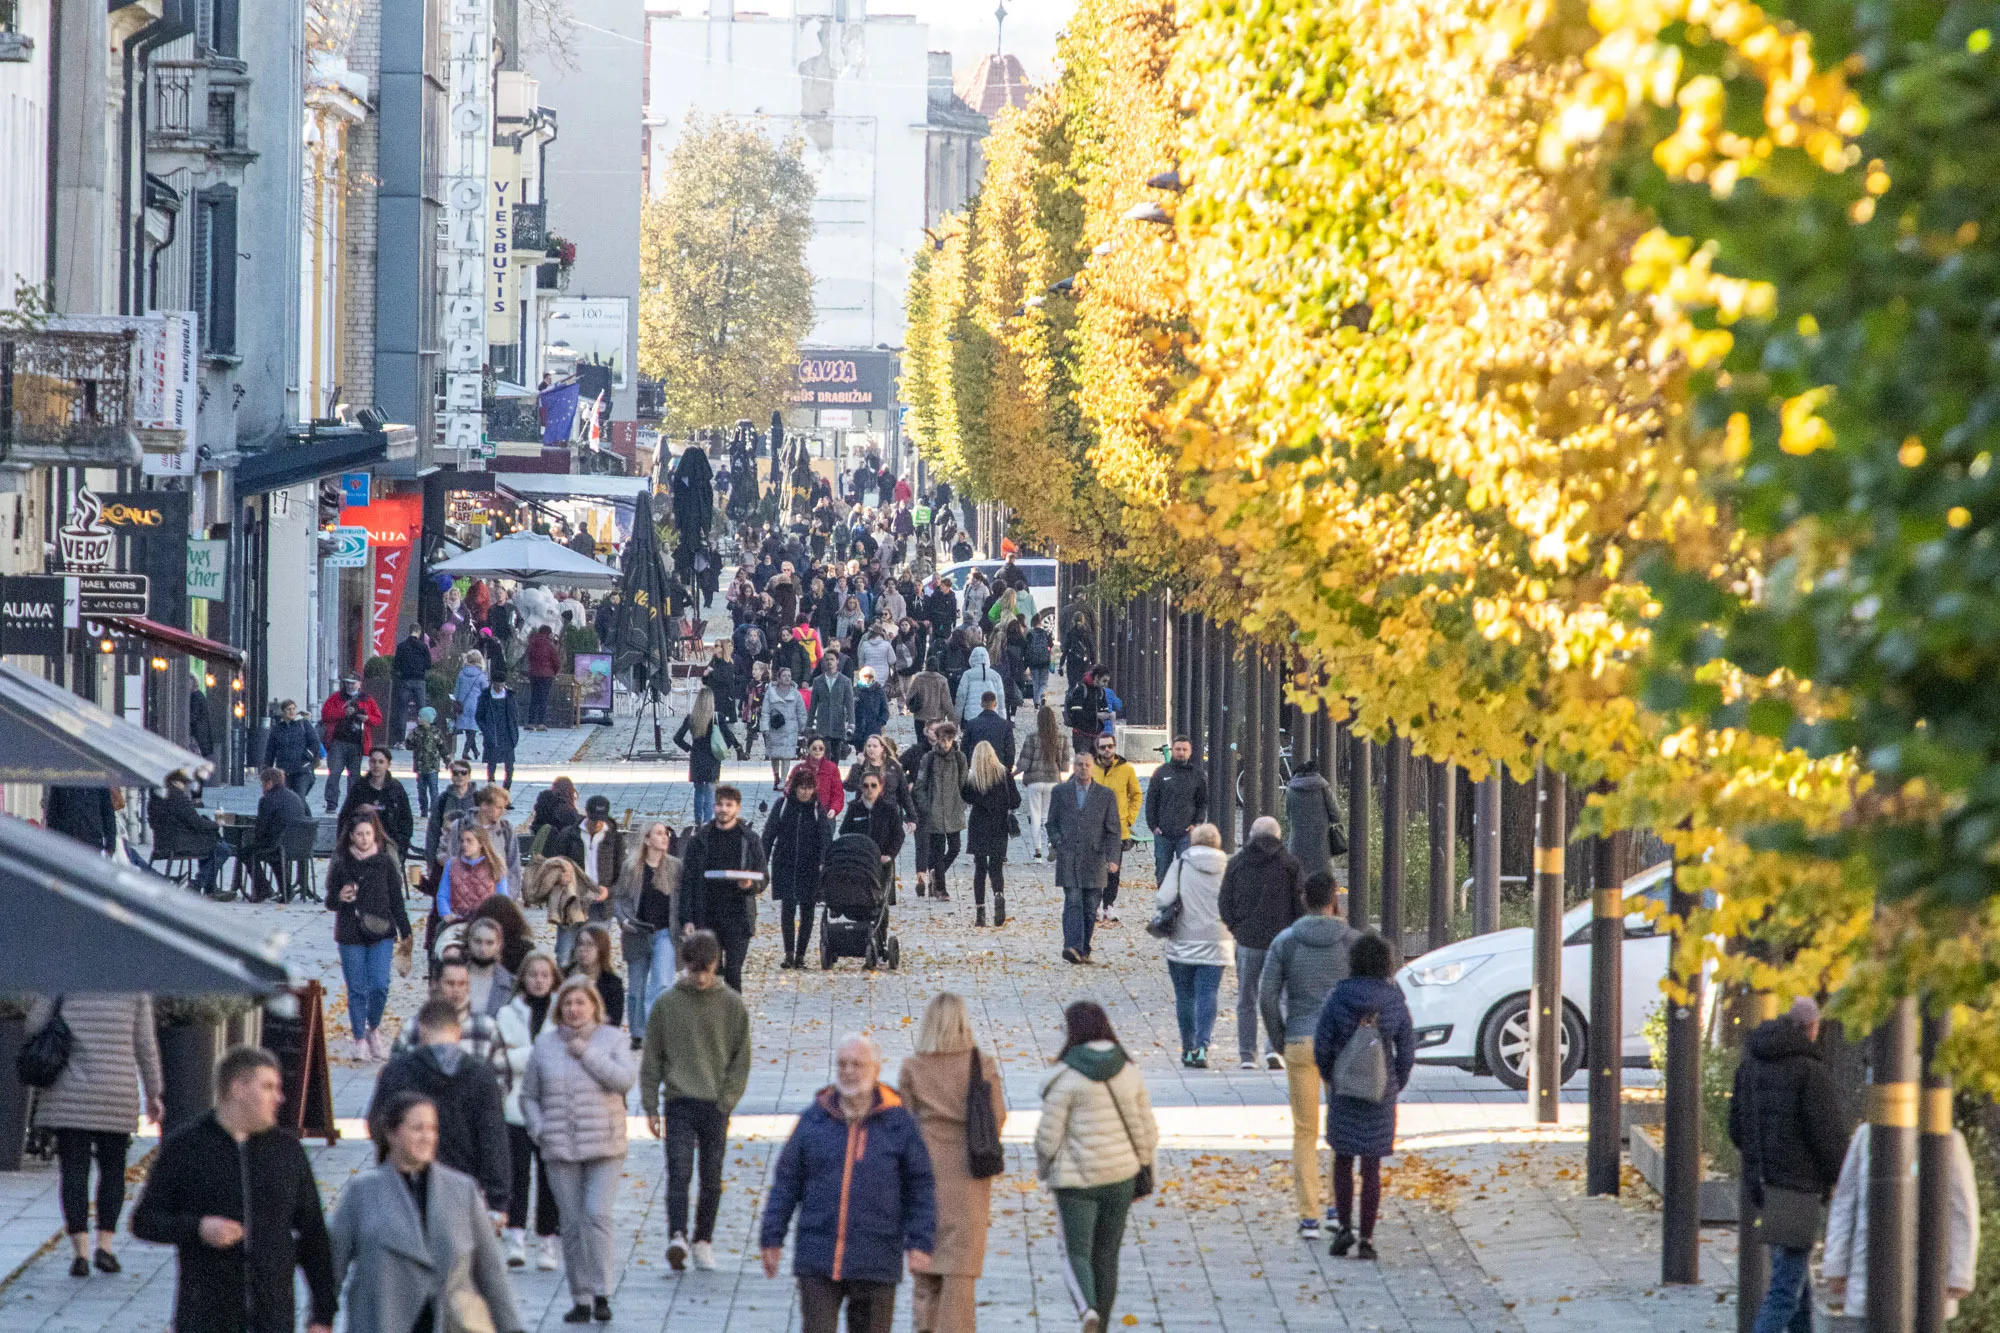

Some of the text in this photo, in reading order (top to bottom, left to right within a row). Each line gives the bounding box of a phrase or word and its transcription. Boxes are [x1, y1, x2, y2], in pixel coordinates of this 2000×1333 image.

[493, 181, 509, 312] VIESBUTIS
[447, 181, 483, 446] CLIPPER
[181, 319, 191, 382] www.rigveda.lt
[817, 388, 872, 402] DRABUŽIAI
[174, 389, 183, 426] MOKYKLA
[271, 490, 289, 515] 17
[365, 531, 407, 542] NIJA
[62, 540, 108, 561] VERO
[325, 559, 366, 567] ENTRAS
[80, 580, 137, 590] HAEL KORS
[187, 566, 220, 587] cher
[3, 601, 53, 618] AUMA
[6, 621, 54, 629] ngerie
